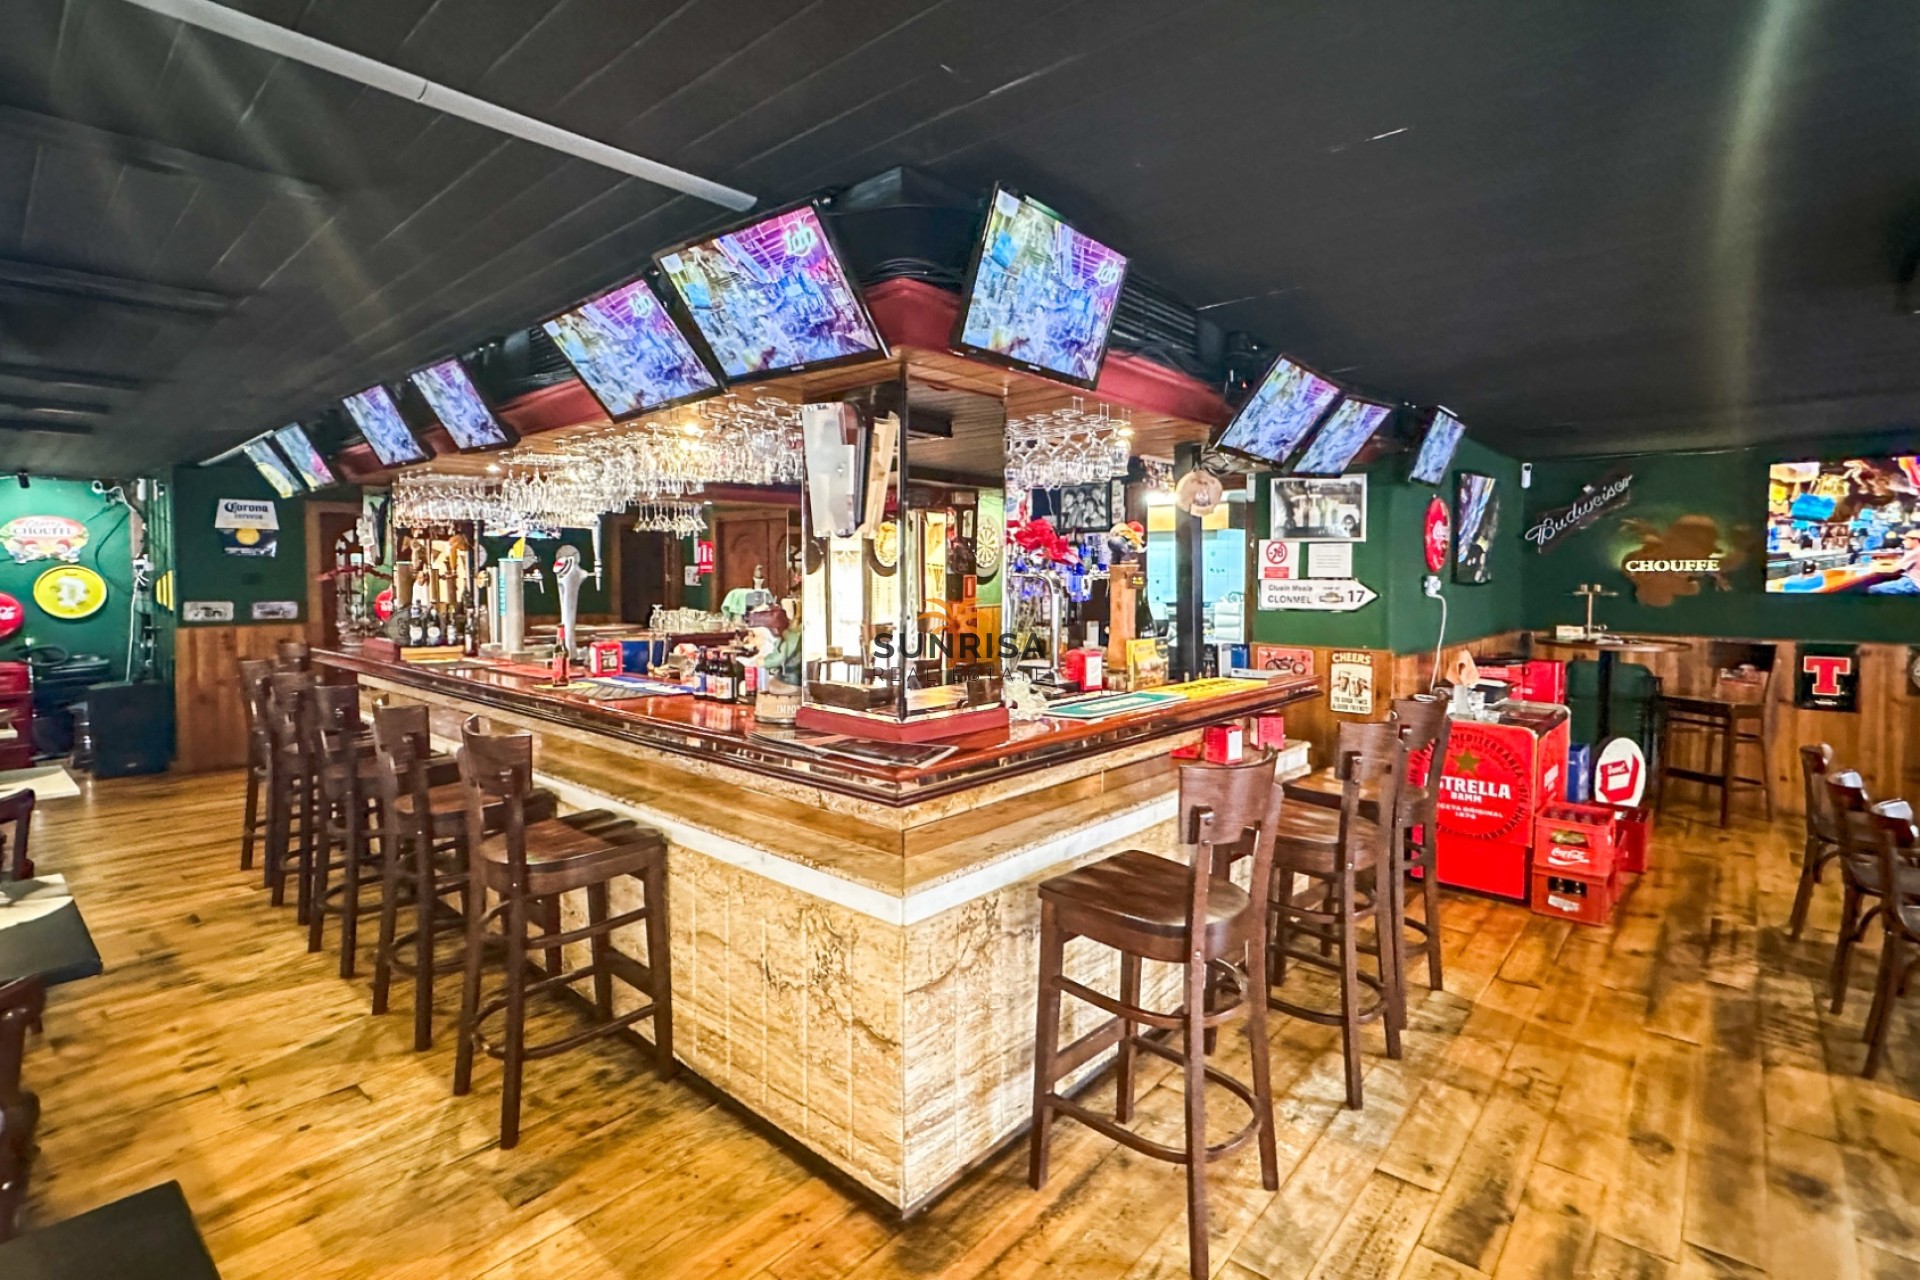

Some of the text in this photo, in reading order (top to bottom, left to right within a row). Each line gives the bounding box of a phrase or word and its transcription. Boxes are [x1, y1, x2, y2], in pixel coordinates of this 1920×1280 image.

[224, 502, 268, 513] Corona
[1525, 475, 1633, 545] Budweiser
[1625, 559, 1720, 572] CHOUFFE
[1267, 594, 1313, 604] CLONMEL
[1347, 590, 1366, 603] 17
[1332, 652, 1371, 665] CHEERS
[1804, 656, 1850, 696] T
[1451, 791, 1482, 803] DAMM
